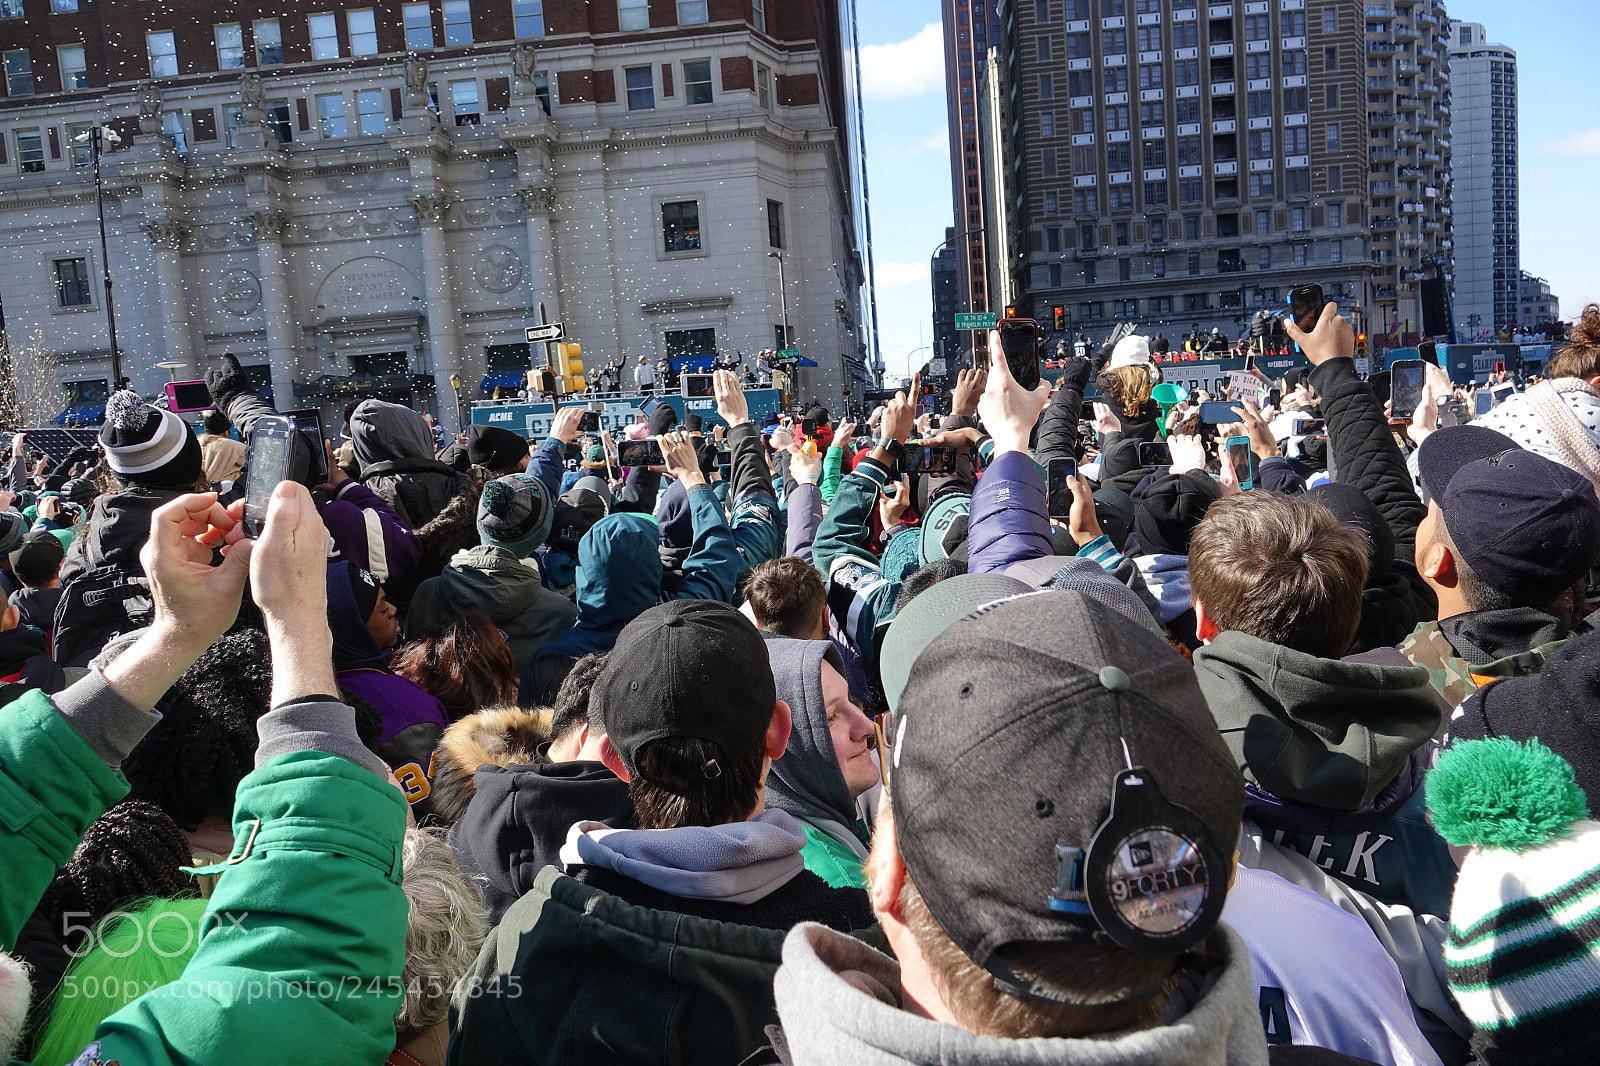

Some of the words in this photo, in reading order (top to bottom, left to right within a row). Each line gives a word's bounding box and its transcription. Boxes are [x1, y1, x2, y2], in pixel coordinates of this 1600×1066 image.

[1075, 346, 1086, 357] 20
[1167, 369, 1207, 377] WORLD
[687, 400, 713, 411] ACME
[488, 411, 514, 423] ACME
[1111, 863, 1201, 901] 9FORTY
